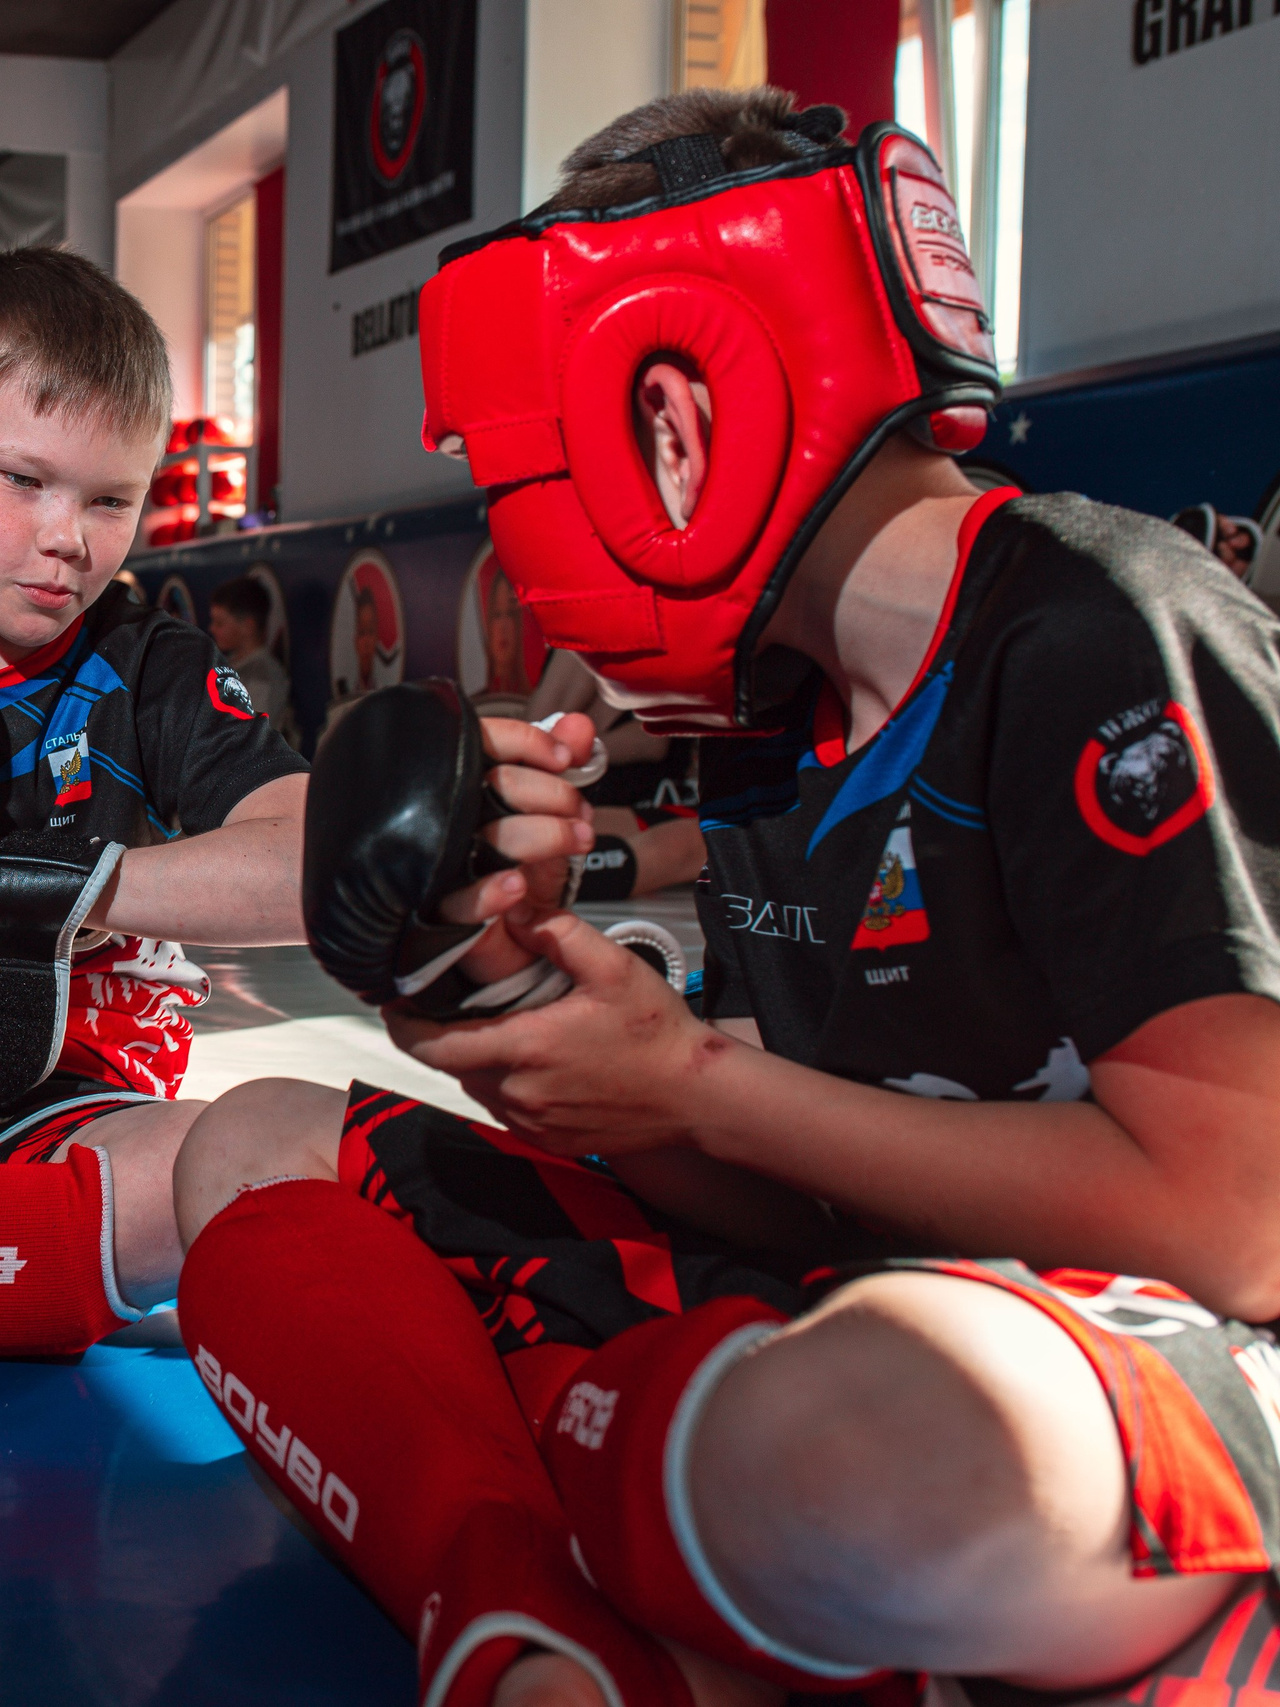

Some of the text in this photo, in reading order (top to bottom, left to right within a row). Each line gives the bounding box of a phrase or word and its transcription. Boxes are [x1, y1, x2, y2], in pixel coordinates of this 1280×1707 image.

[50, 813, 76, 827] ЩИТ
[865, 965, 909, 986] ЩИТ
[194, 1343, 360, 1543] BOYBO
